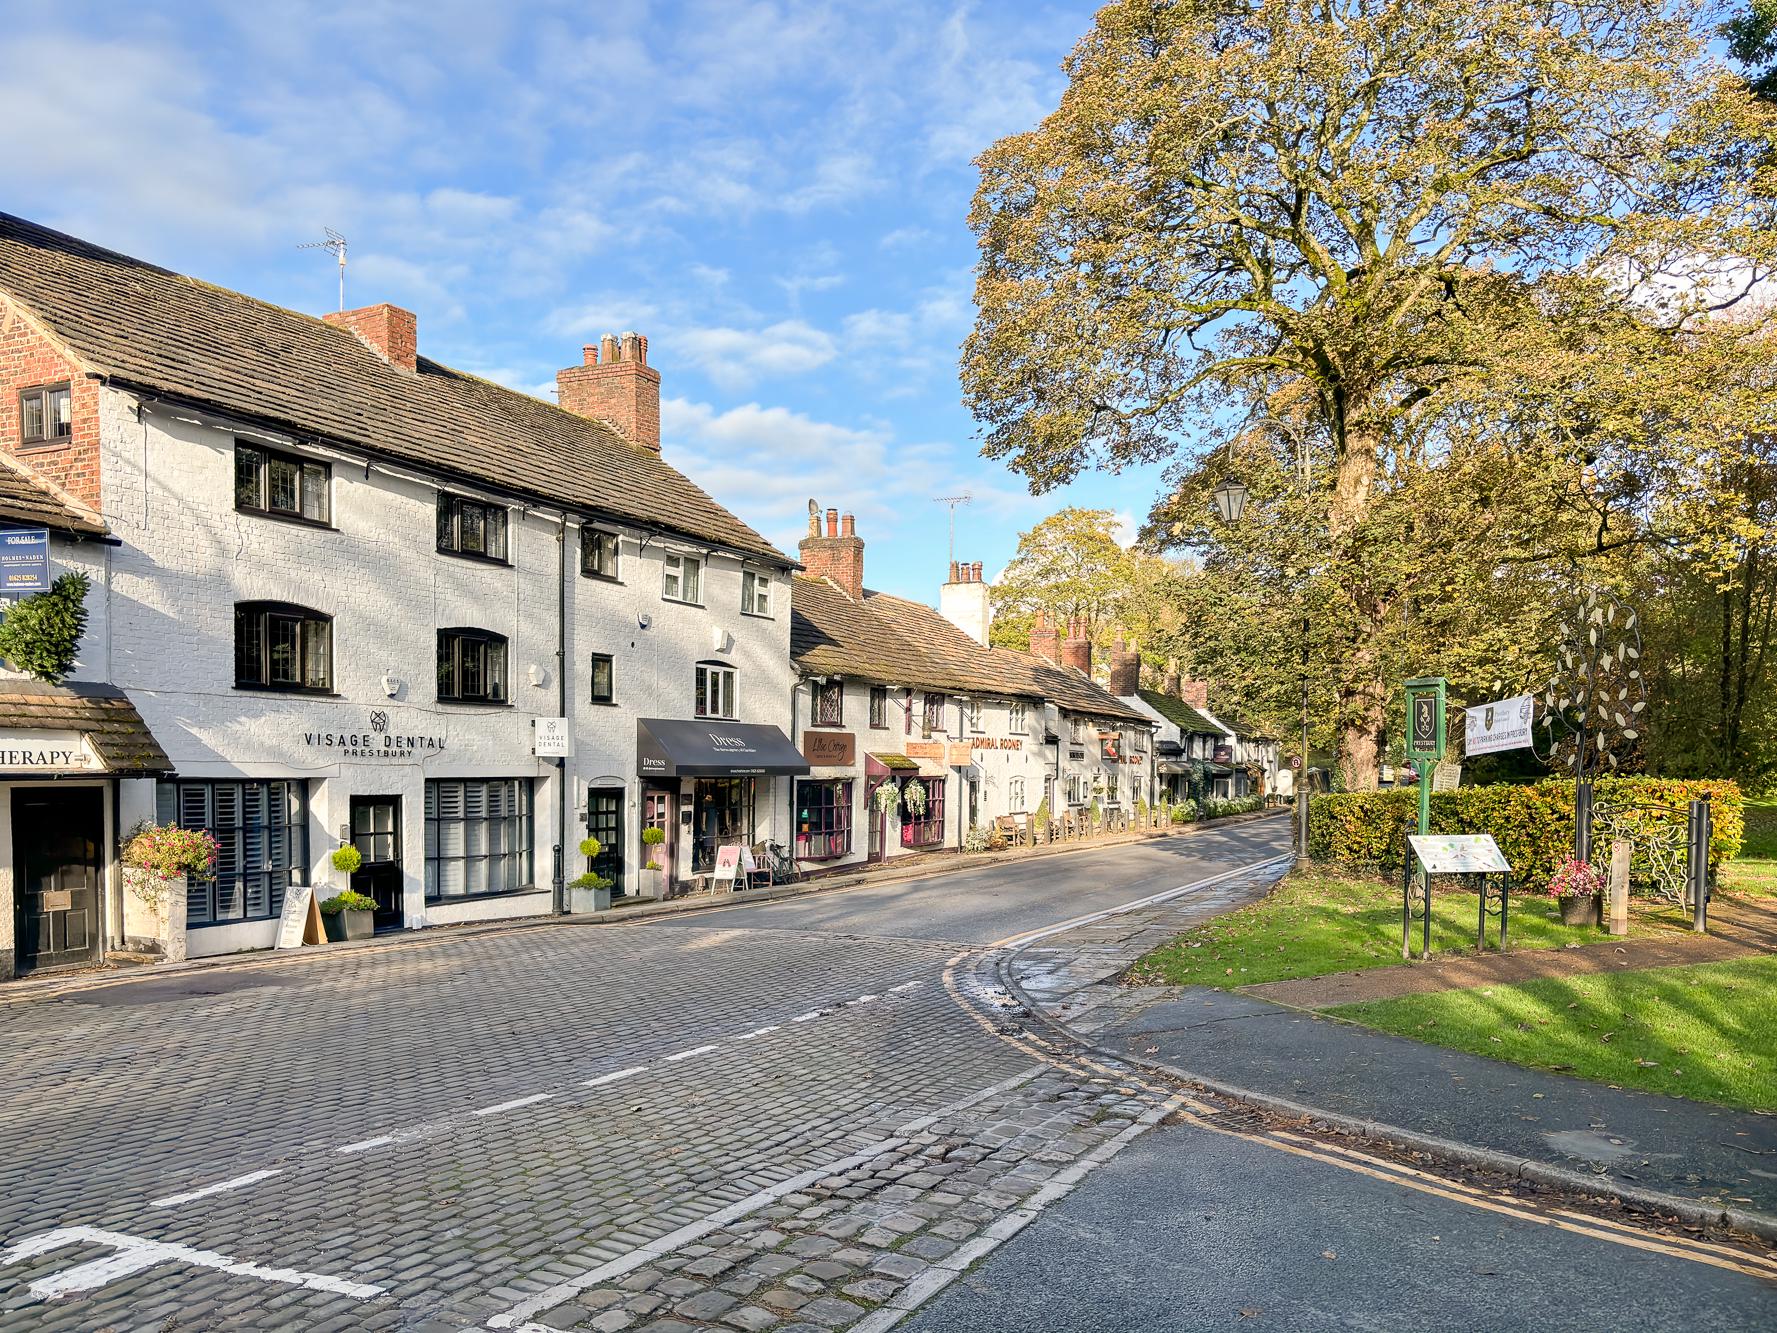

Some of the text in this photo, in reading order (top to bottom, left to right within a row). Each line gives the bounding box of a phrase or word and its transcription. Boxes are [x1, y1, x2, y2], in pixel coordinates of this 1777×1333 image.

[7, 536, 36, 544] FOR SALE
[304, 732, 445, 749] VISAGE DENTAL
[708, 734, 746, 746] Dress
[972, 737, 1022, 750] ADMIRAL RODNEY
[344, 748, 412, 757] PRESTBURY
[643, 757, 666, 766] Dress
